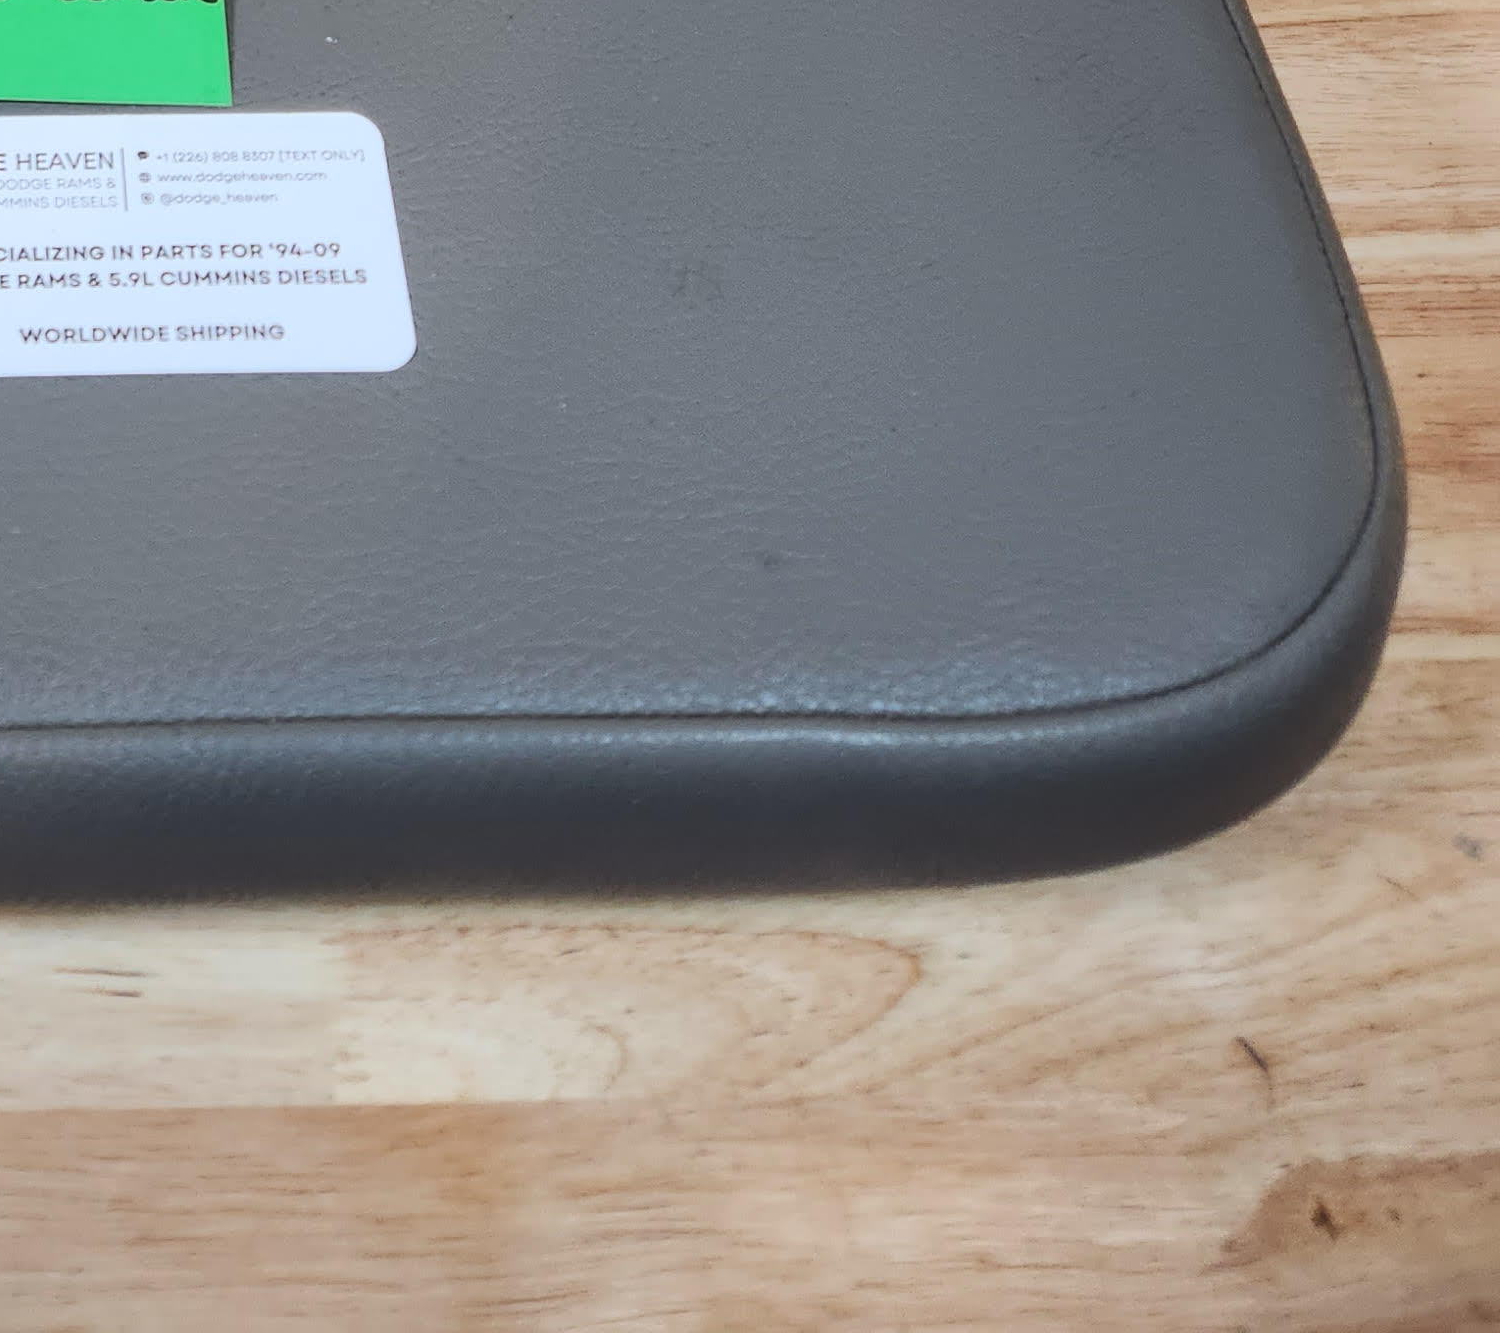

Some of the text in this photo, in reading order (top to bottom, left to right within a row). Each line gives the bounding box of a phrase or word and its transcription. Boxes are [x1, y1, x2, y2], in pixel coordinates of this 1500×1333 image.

[16, 151, 114, 171] HEAVEN
[56, 176, 102, 190] RAMS
[105, 177, 117, 189] &
[157, 170, 328, 185] www.dodgeheaven.com
[54, 195, 119, 209] DIESELS
[159, 192, 279, 207] @dodge_heaven
[112, 245, 133, 260] IN
[141, 244, 213, 259] PARTS
[219, 244, 263, 259] FOR
[17, 273, 81, 288] RAMS
[88, 272, 101, 287] &
[109, 271, 154, 287] 5.9L
[160, 270, 271, 286] CUMMINS
[277, 269, 367, 285] DIESELS
[19, 324, 285, 344] WORLDWIDE SHIPPING
